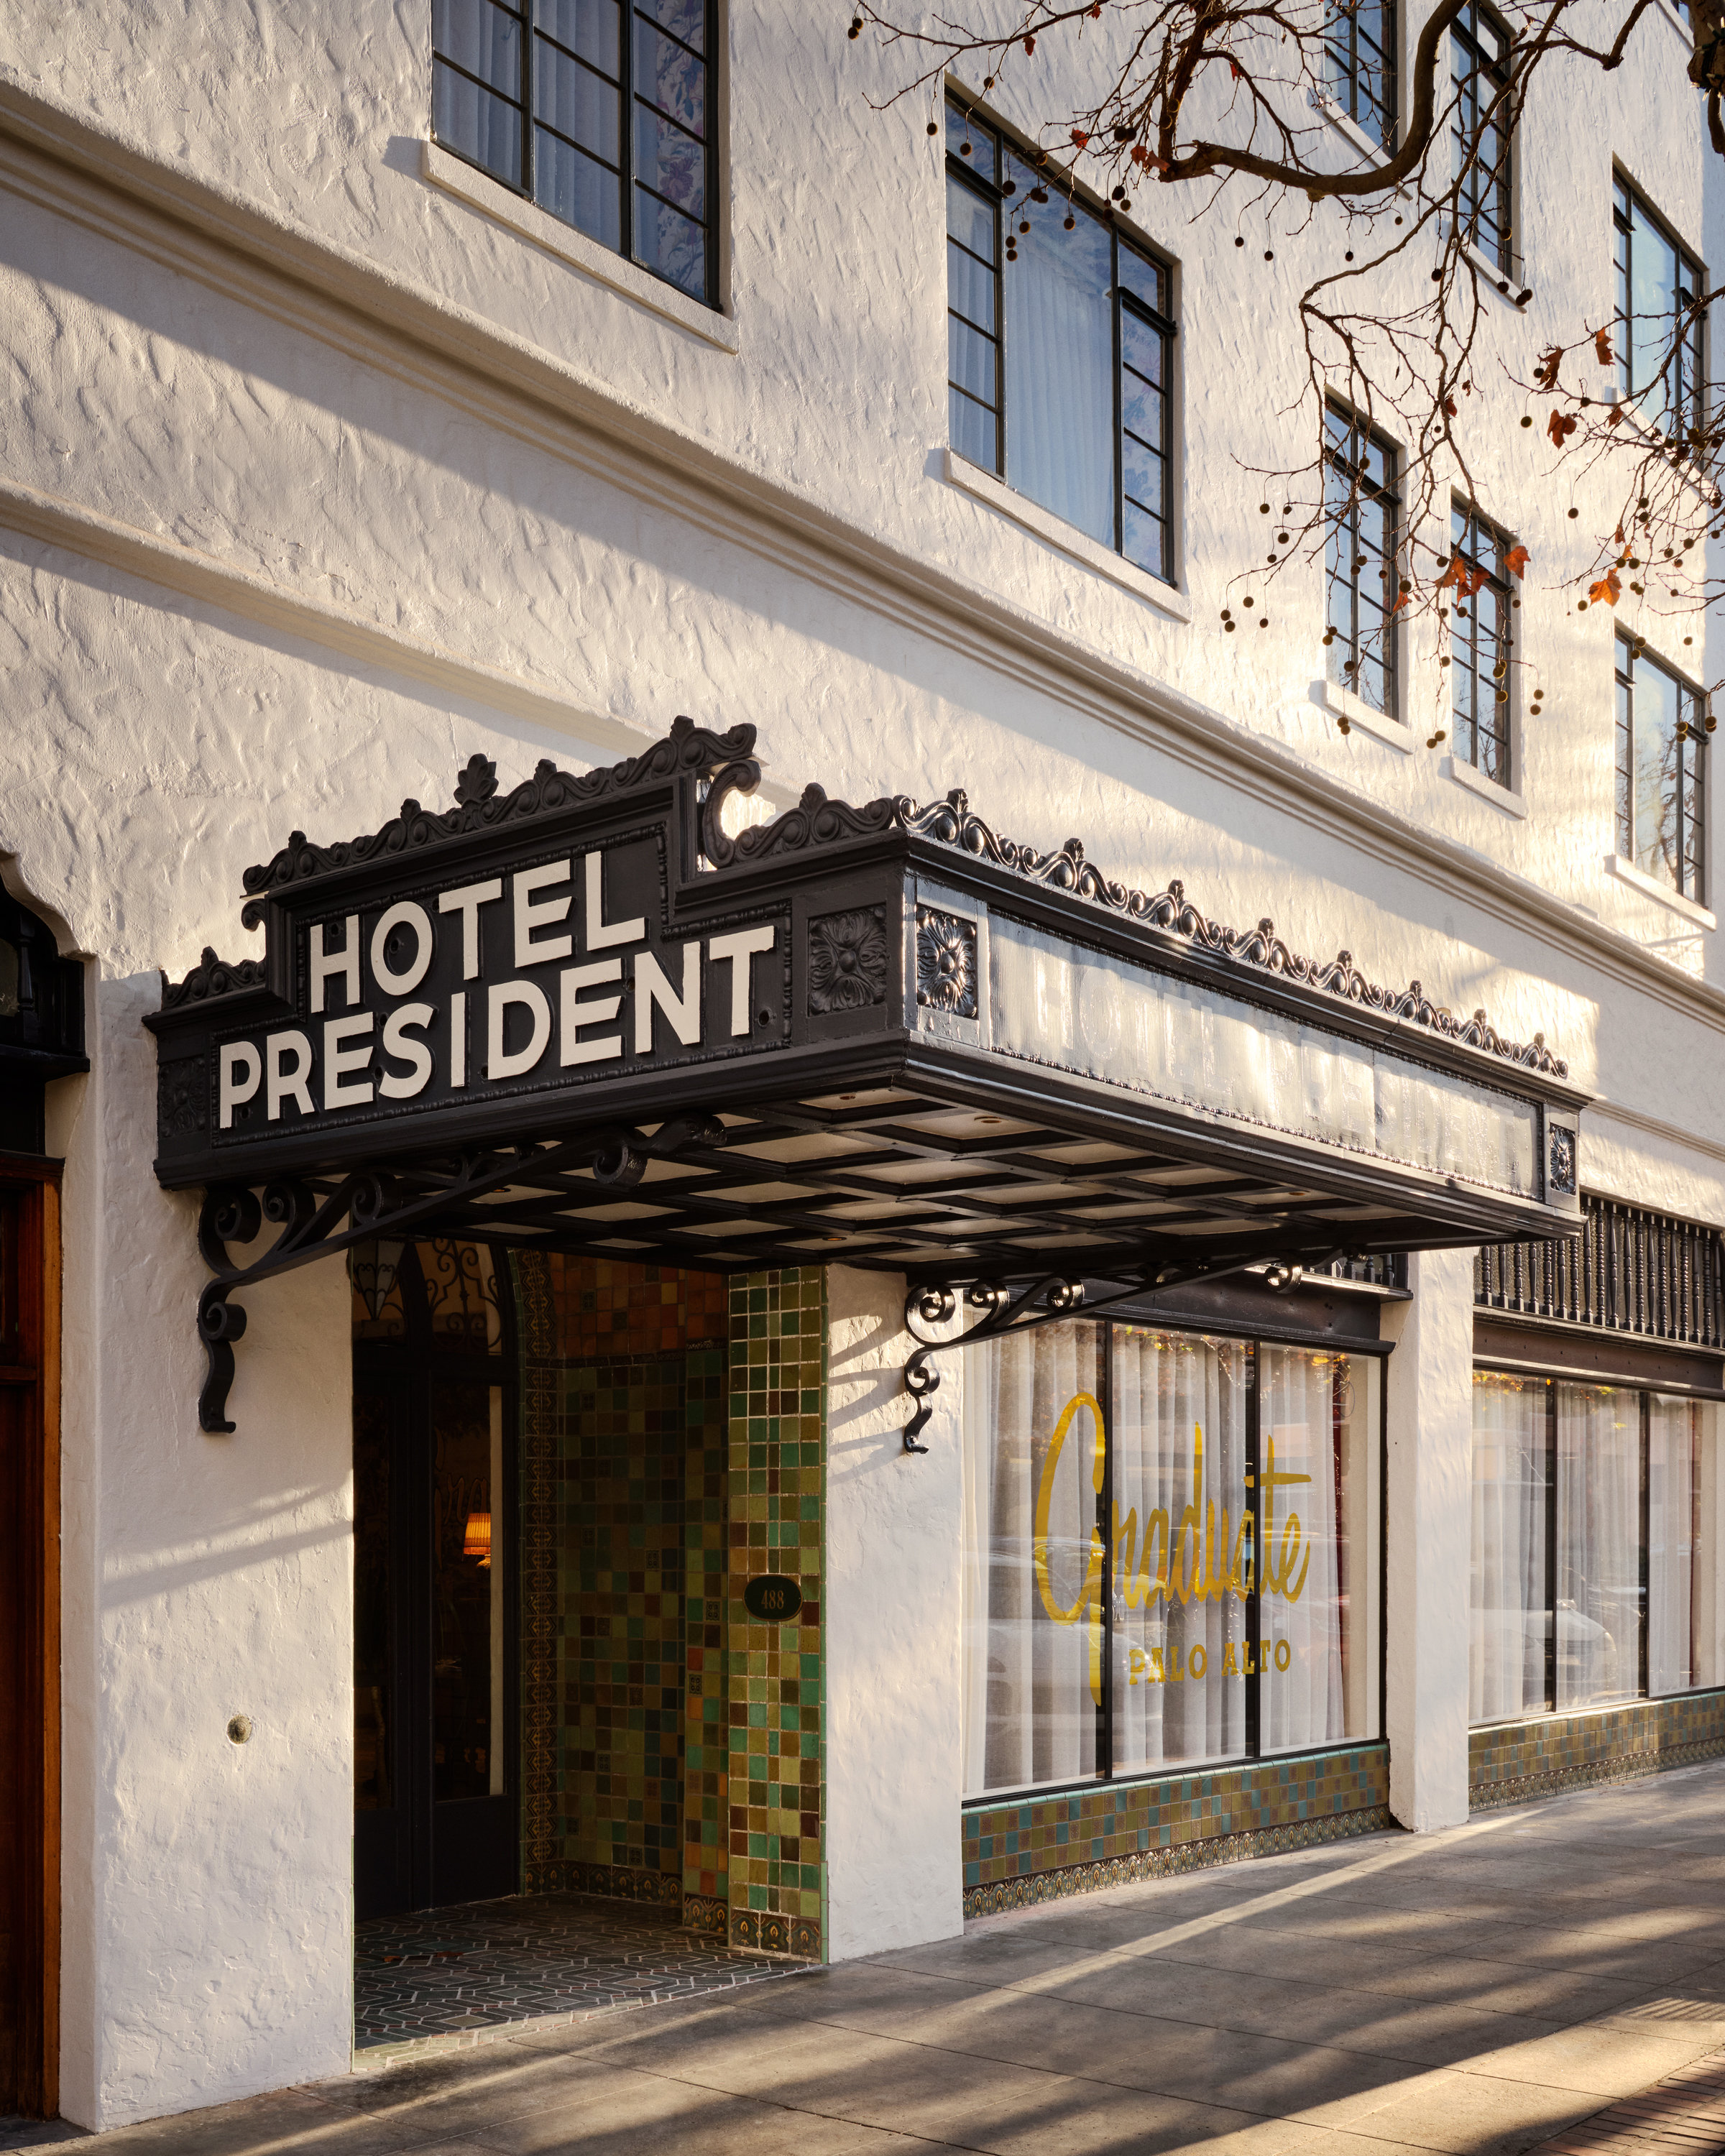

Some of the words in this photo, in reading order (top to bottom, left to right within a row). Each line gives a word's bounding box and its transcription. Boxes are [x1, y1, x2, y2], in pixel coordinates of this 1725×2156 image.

[310, 851, 646, 1013] HOTEL
[219, 926, 775, 1129] PRESIDENT
[760, 1589, 784, 1610] 488
[1034, 1391, 1312, 1706] Graduate
[1128, 1644, 1208, 1685] PALO
[1221, 1639, 1291, 1677] ALTO
